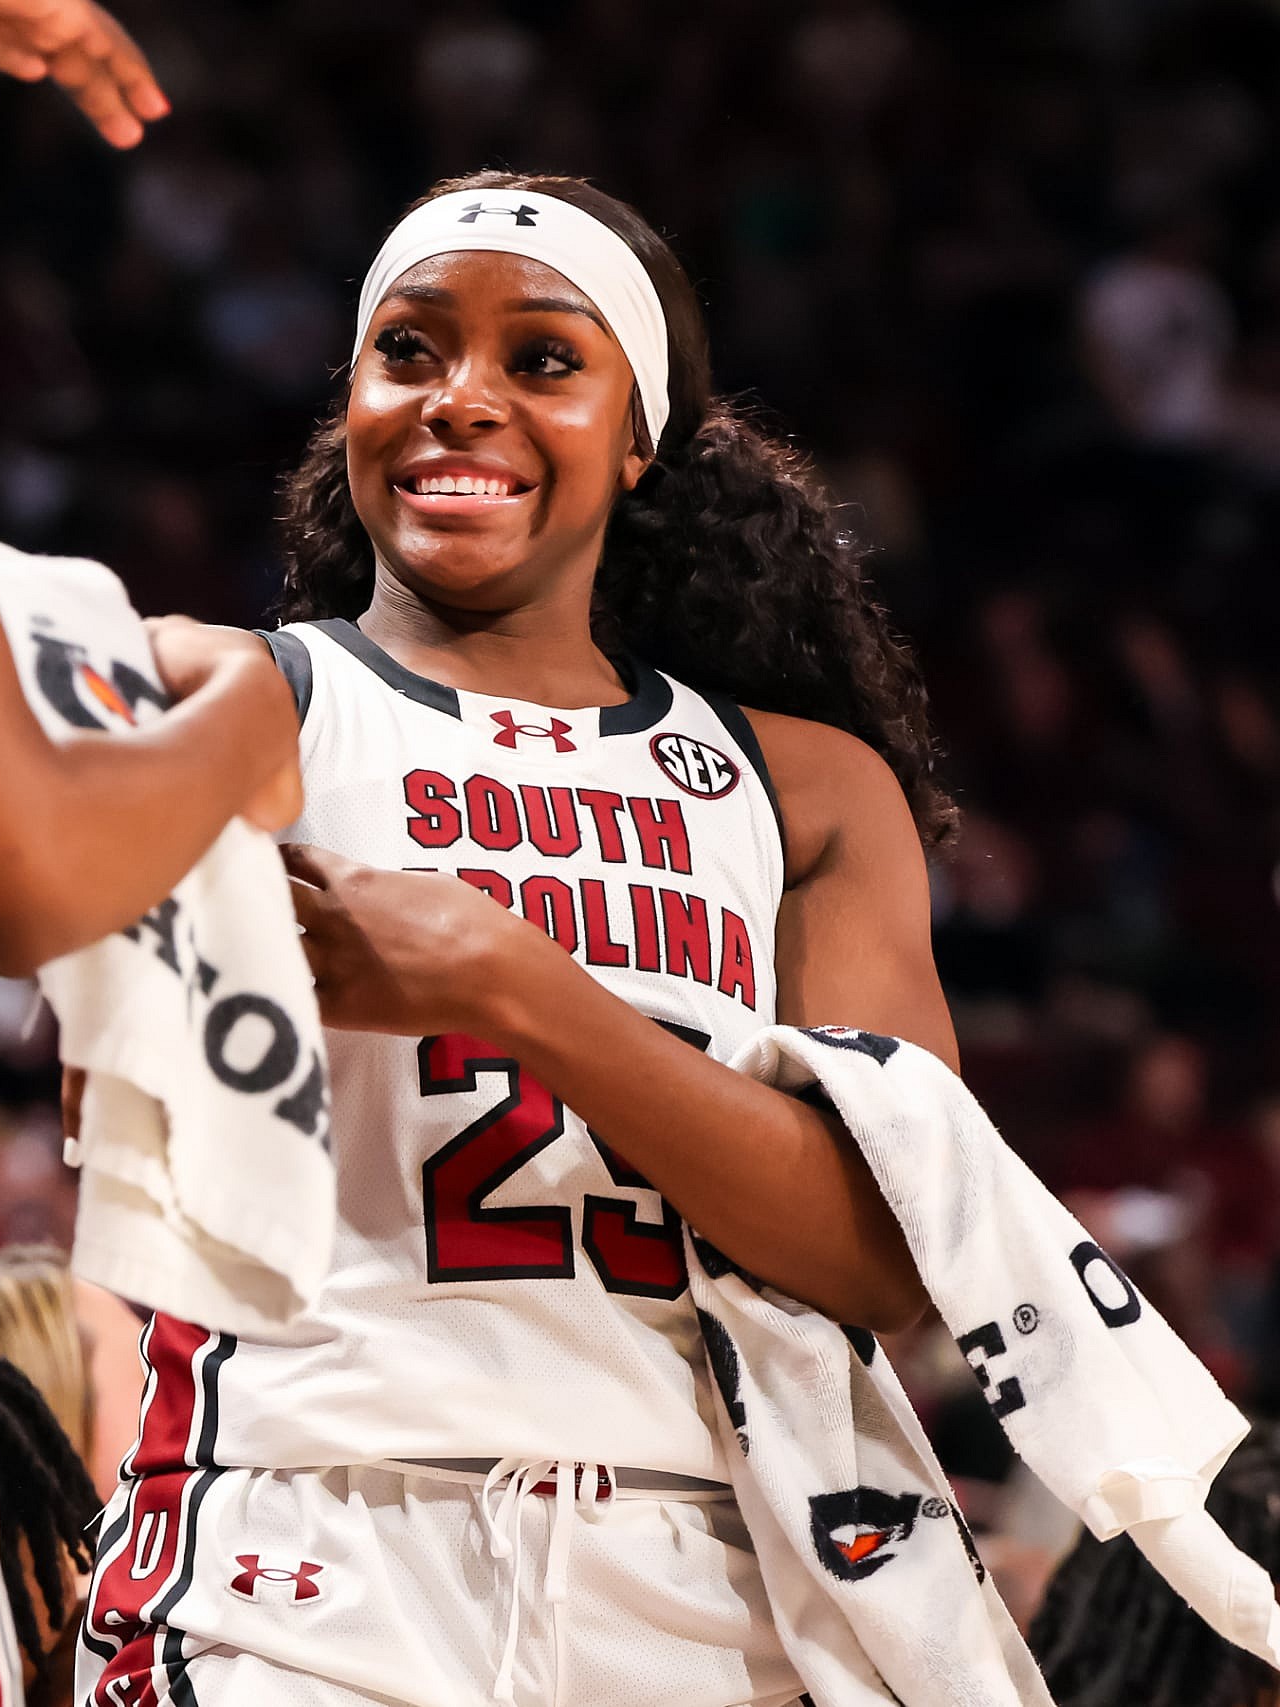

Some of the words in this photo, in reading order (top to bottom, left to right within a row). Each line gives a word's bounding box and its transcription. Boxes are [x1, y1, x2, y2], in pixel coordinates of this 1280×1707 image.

[657, 735, 733, 794] SEC
[403, 768, 693, 876] SOUTH
[402, 867, 757, 1012] OLINA
